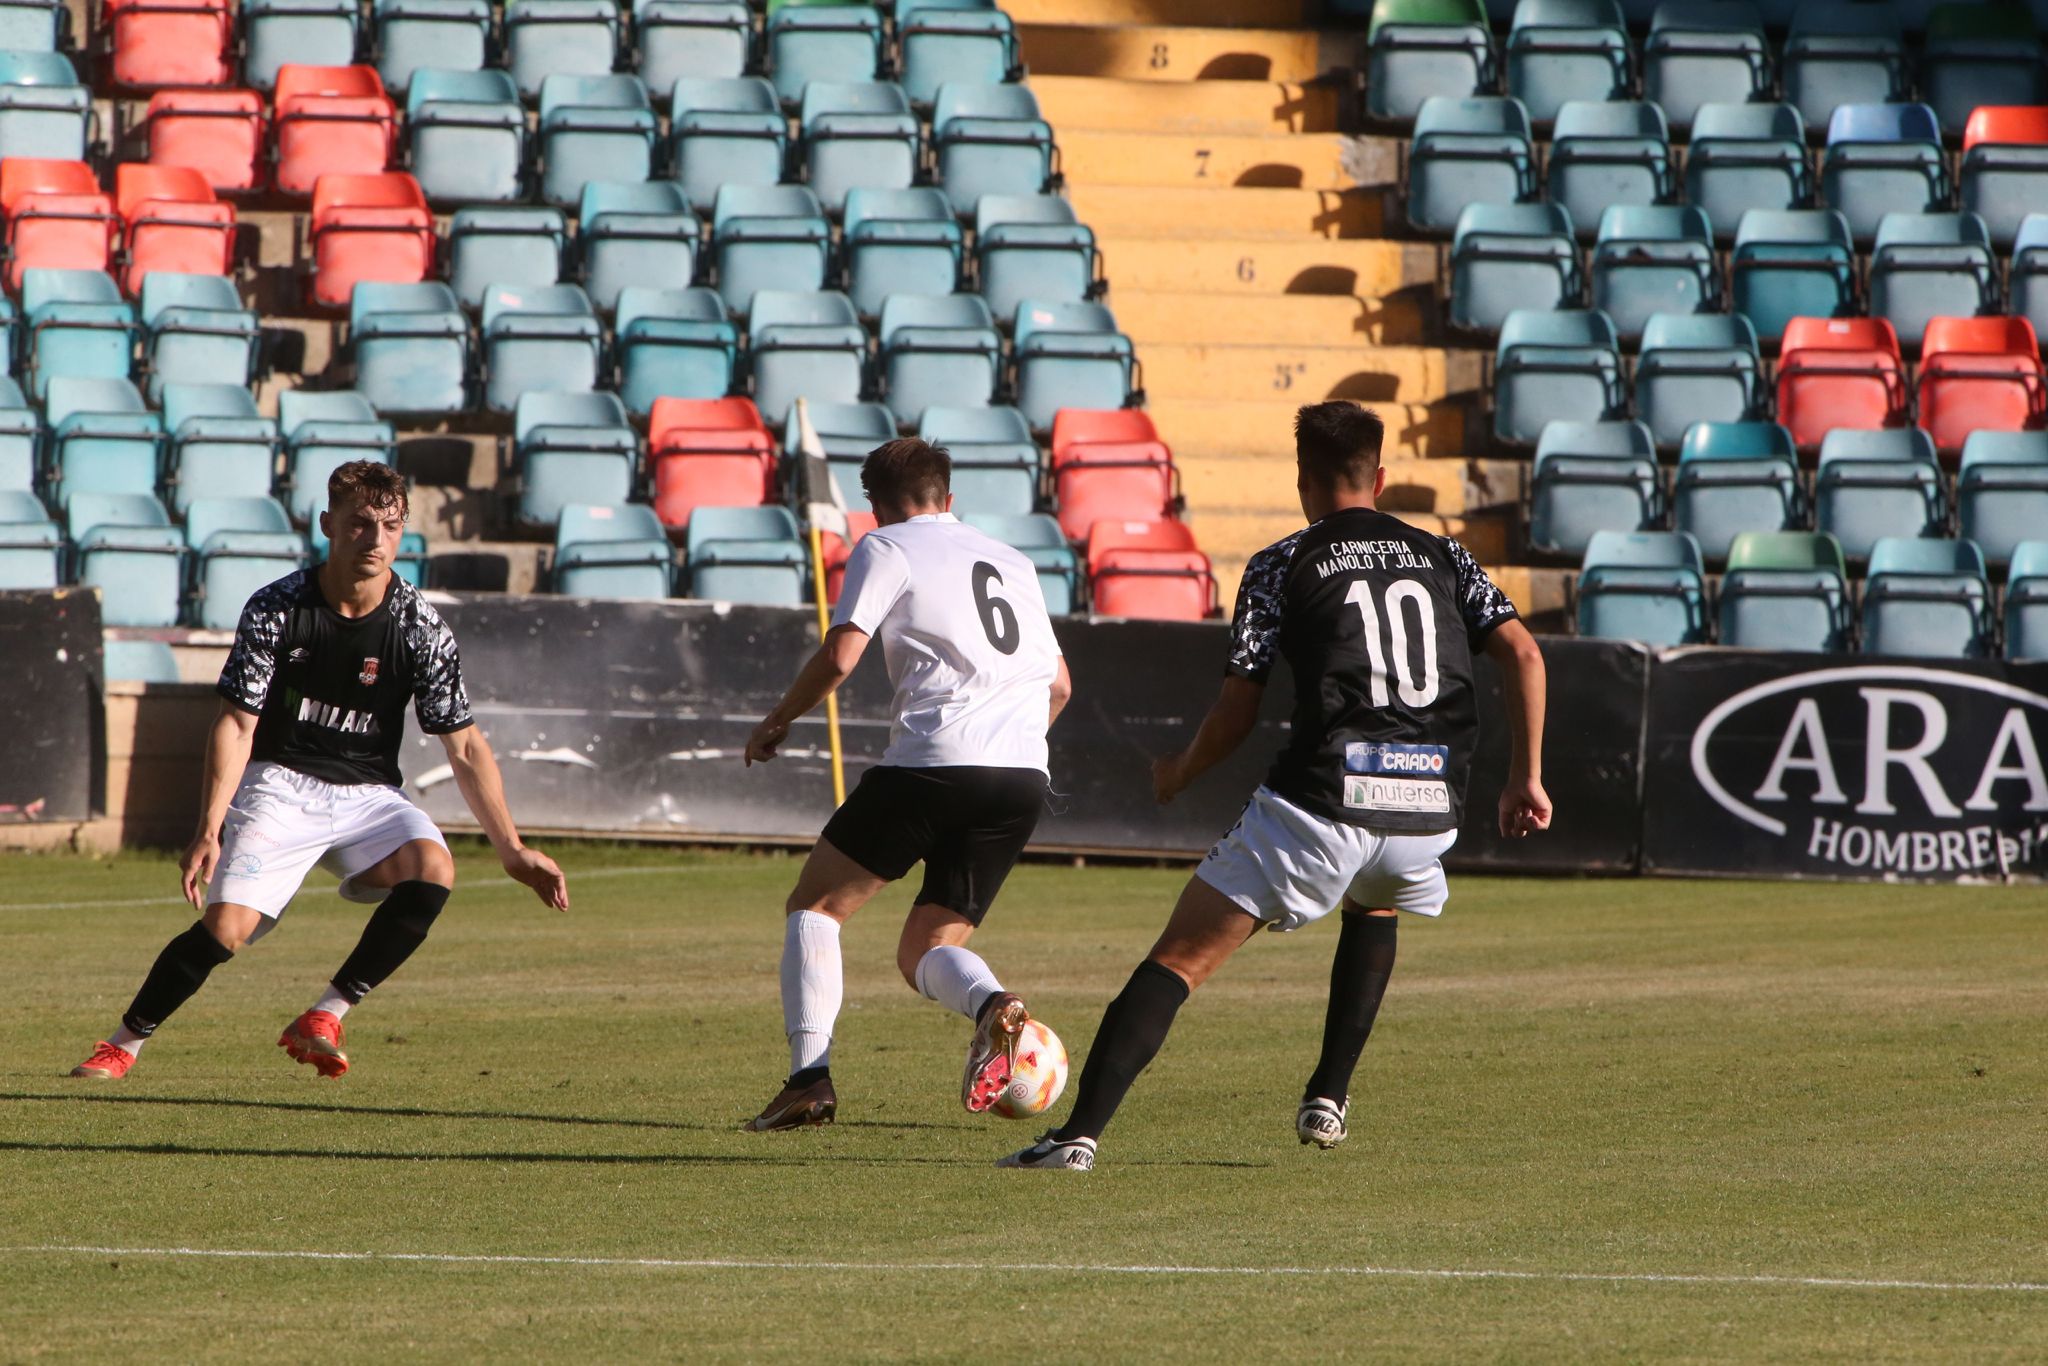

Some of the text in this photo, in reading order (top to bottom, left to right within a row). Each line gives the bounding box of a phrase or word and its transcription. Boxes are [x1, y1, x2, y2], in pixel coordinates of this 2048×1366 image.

[1150, 43, 1168, 70] 8
[1195, 150, 1211, 178] 7
[1237, 258, 1255, 282] 6
[1330, 540, 1411, 556] CARNICERIA
[1316, 554, 1434, 578] MANOLO Y JULIA
[971, 560, 1020, 656] 6
[1343, 579, 1440, 708] 10
[1382, 752, 1444, 771] CRIADO
[1371, 781, 1448, 804] nutersa
[1302, 1113, 1335, 1134] NIKE
